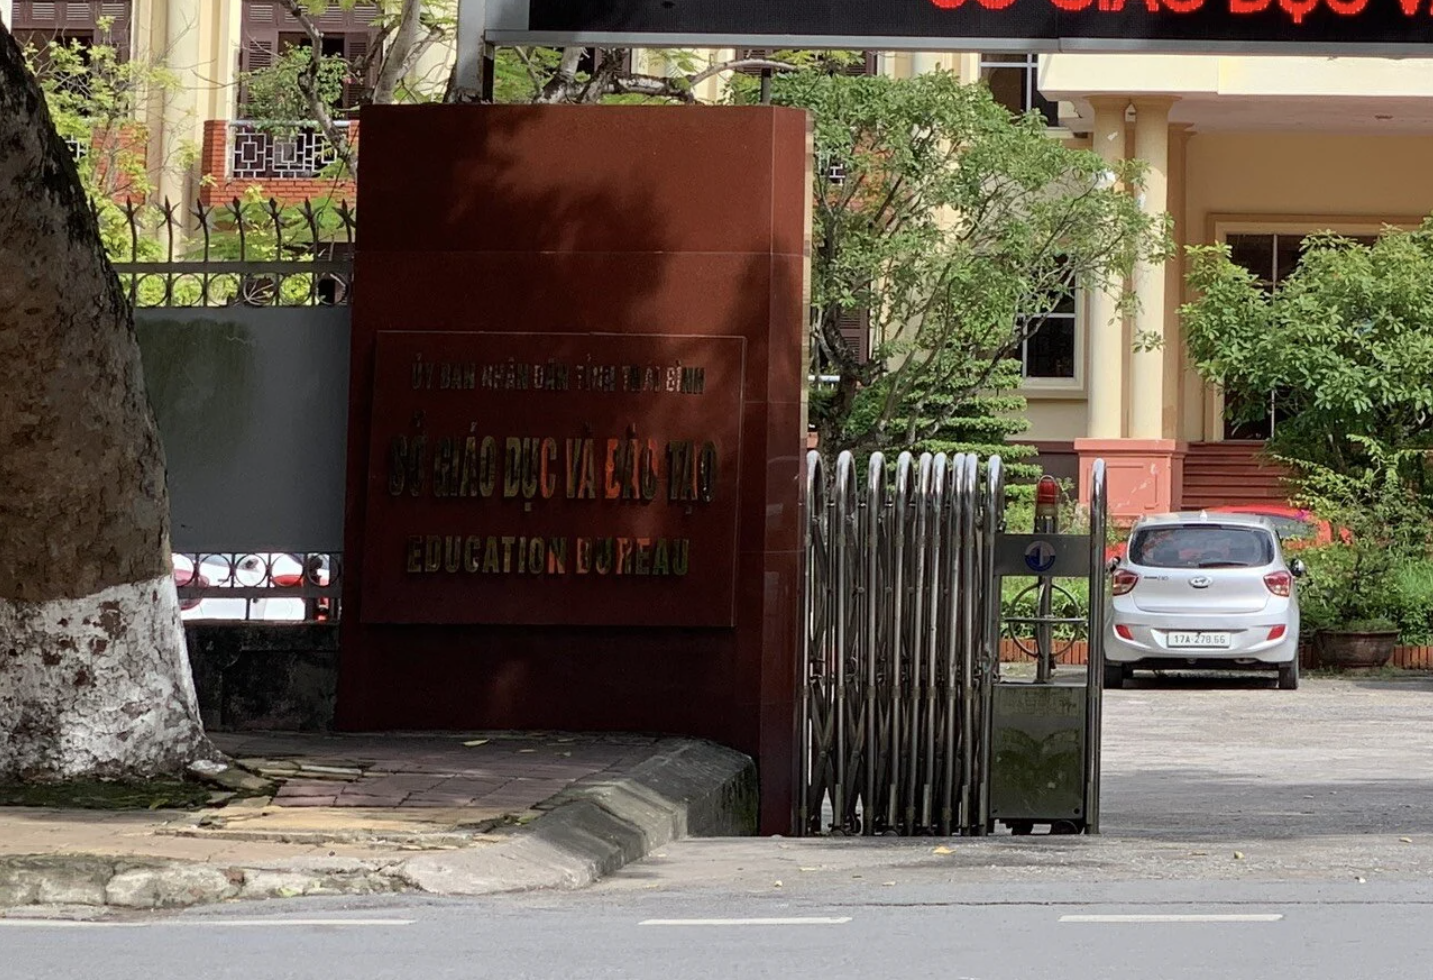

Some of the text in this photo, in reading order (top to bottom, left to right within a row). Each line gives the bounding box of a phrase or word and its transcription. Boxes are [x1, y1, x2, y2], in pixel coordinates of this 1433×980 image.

[440, 361, 475, 390] BAN
[433, 421, 498, 498] GIÁO
[503, 436, 558, 512] DỤC
[667, 440, 717, 515] TẠO
[407, 534, 690, 577] EDUCATION BUREAU
